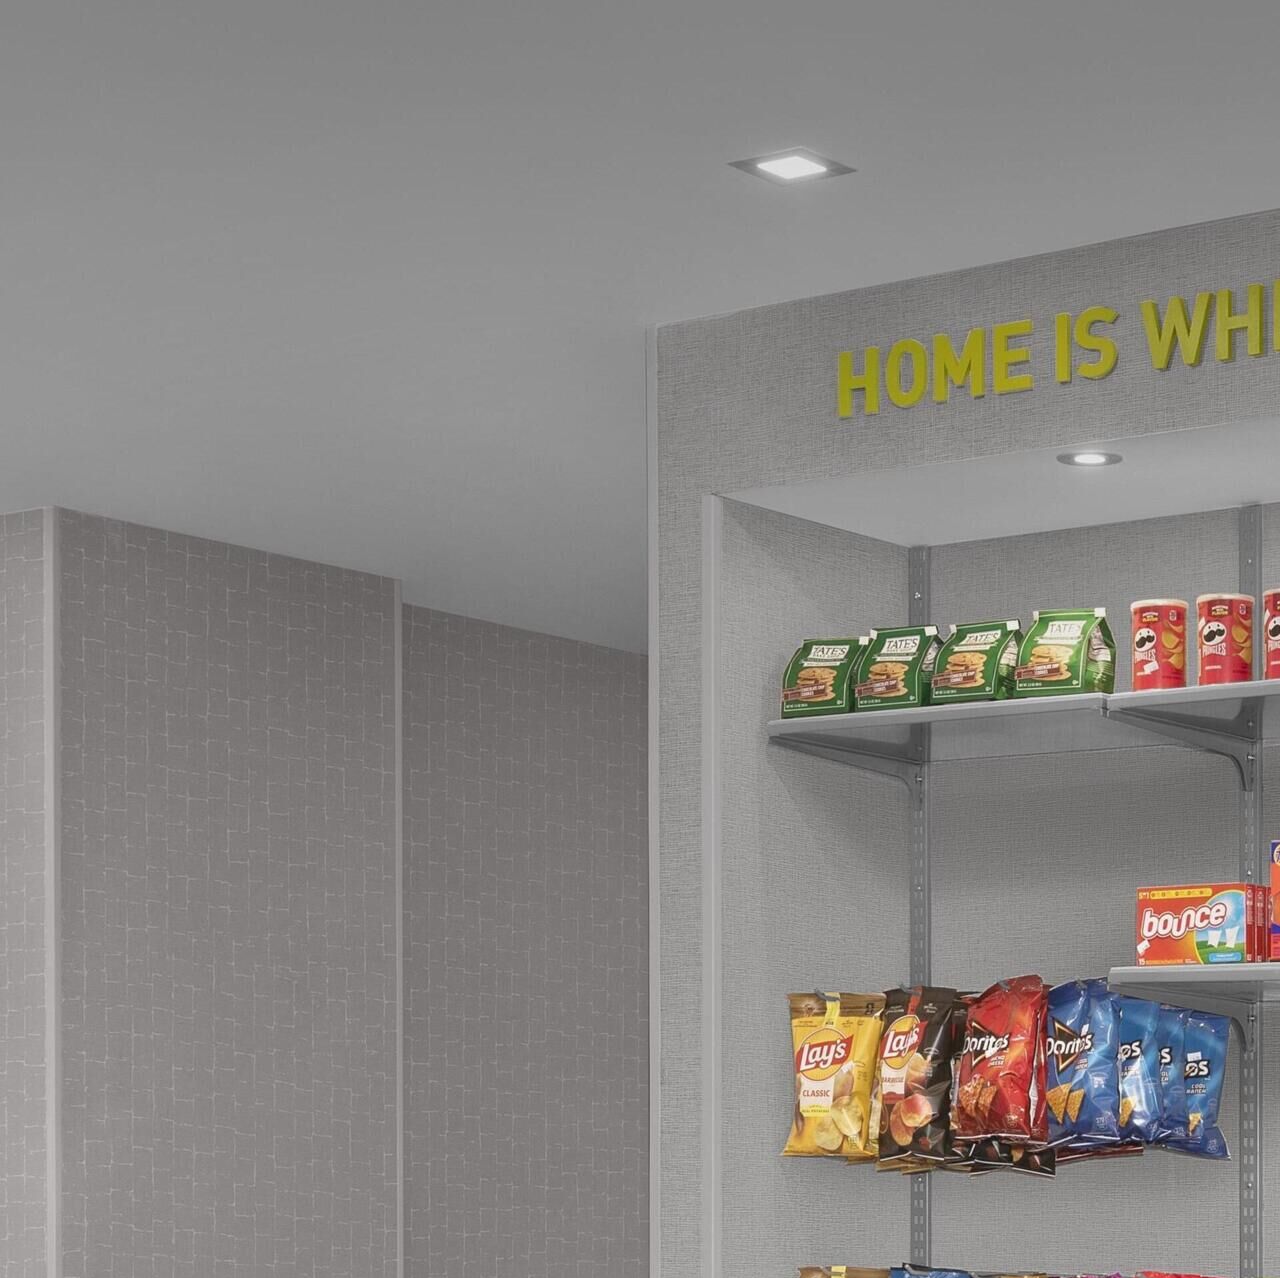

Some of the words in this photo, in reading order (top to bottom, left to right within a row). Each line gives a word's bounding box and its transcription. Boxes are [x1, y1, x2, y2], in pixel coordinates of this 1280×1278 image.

[839, 321, 1032, 416] HOME
[1056, 308, 1117, 383] IS
[814, 647, 847, 655] TATE'S
[887, 639, 918, 649] TATE'S
[1202, 643, 1226, 656] PRINGLES
[1142, 902, 1226, 939] bounce
[800, 1040, 846, 1071] Lay's
[883, 1027, 919, 1058] Lay's
